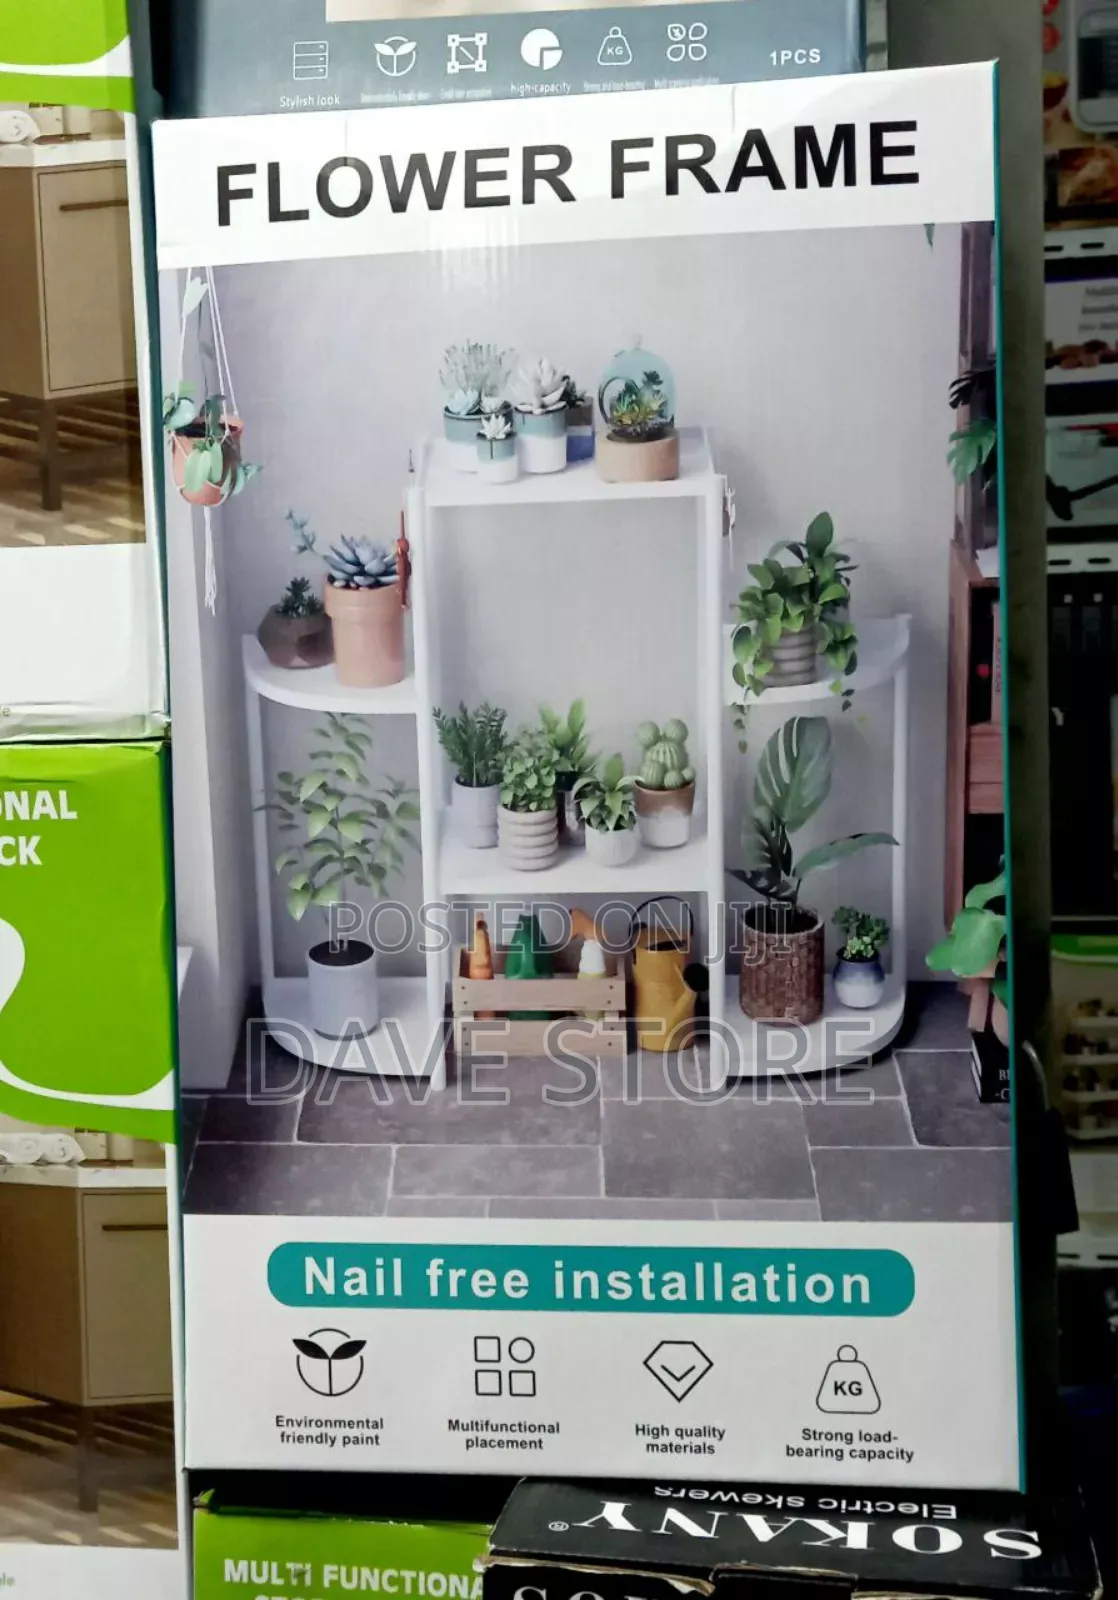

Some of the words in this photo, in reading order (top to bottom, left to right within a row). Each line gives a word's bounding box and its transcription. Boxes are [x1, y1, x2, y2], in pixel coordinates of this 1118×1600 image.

[769, 48, 821, 66] 1PCS
[510, 80, 571, 96] high-capacity
[280, 95, 314, 110] Stylish
[317, 93, 340, 106] look
[217, 143, 576, 227] FLOWER
[610, 120, 919, 203] FRAME
[0, 790, 78, 820] NAL
[304, 1256, 404, 1296] Nail
[426, 1259, 529, 1299] free
[554, 1260, 871, 1304] installation
[833, 1381, 863, 1396] KG
[275, 1415, 384, 1430] Environmental
[448, 1419, 560, 1434] Multifunctional
[280, 1432, 337, 1447] friendly
[342, 1434, 380, 1447] paint
[635, 1424, 669, 1439] High
[674, 1425, 726, 1441] quality
[801, 1428, 854, 1444] Strong
[858, 1430, 898, 1444] load-
[465, 1436, 544, 1451] placement
[645, 1442, 715, 1455] materials
[786, 1444, 845, 1461] bearing
[849, 1447, 914, 1463] capacity
[653, 1485, 805, 1509] skewers
[818, 1497, 957, 1519] Electric
[224, 1558, 311, 1587] MULTI
